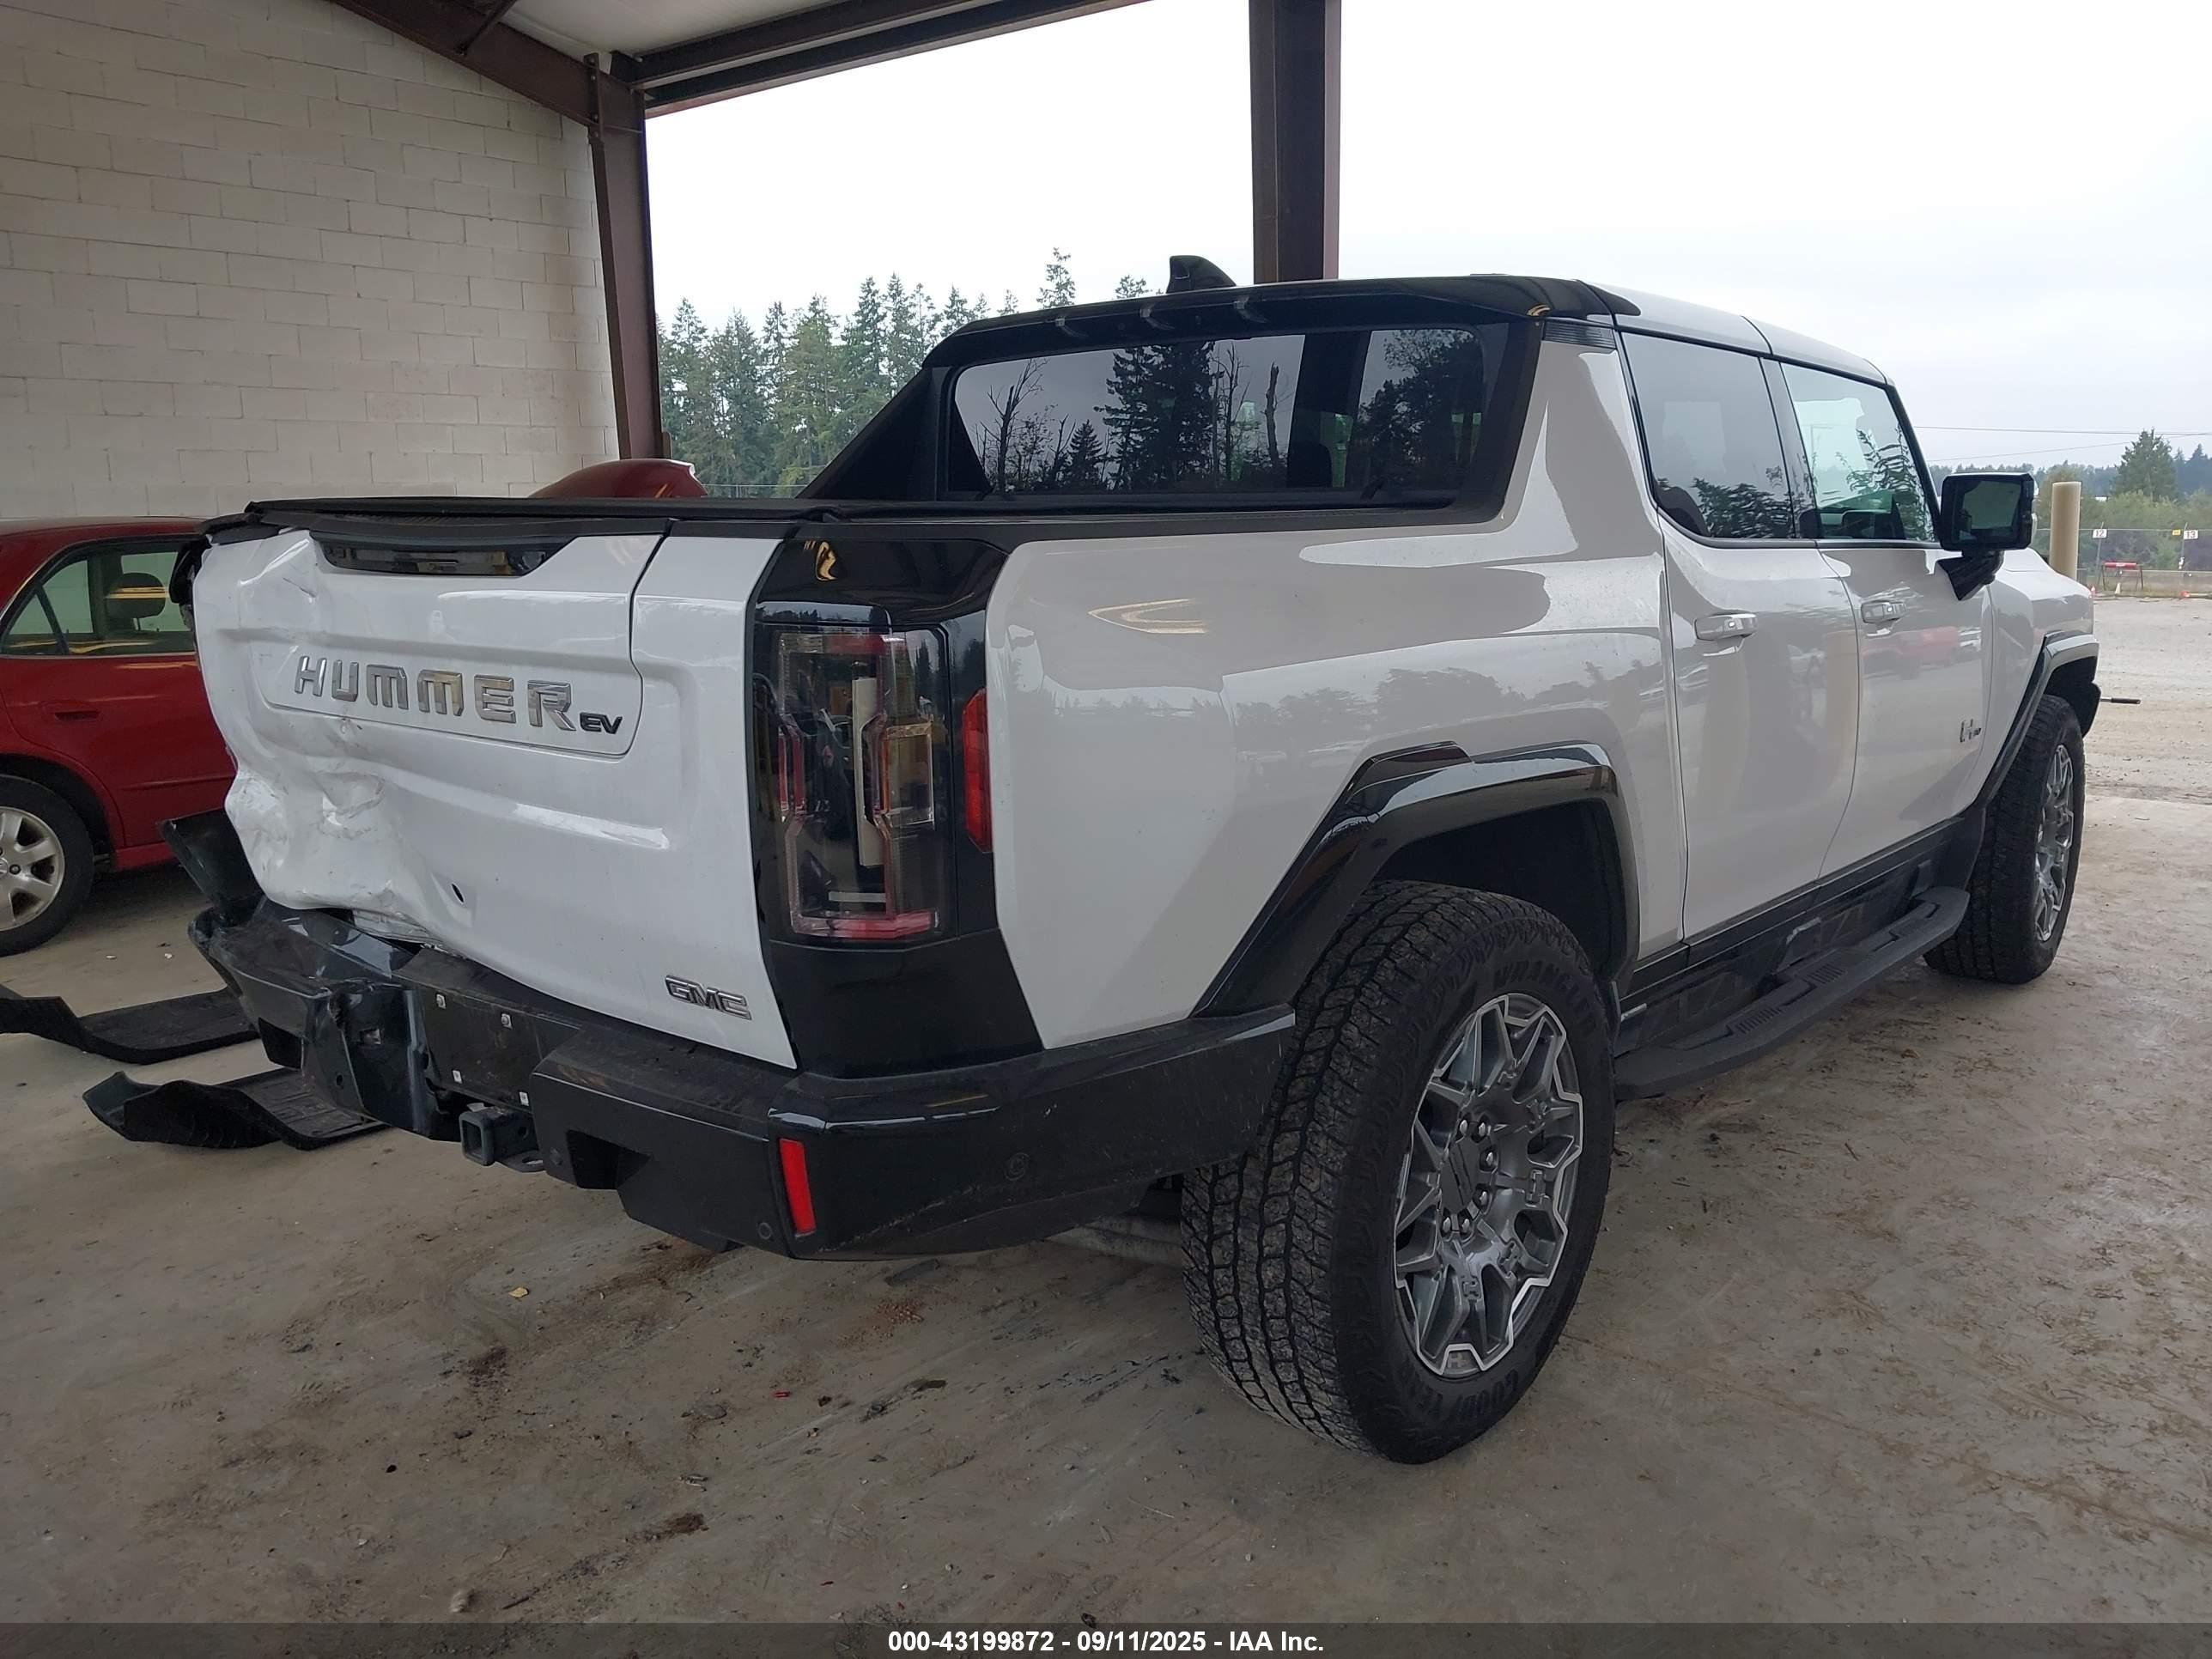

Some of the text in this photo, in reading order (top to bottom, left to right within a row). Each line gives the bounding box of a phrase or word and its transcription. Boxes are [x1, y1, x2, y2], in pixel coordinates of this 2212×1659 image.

[295, 655, 623, 734] HUMMER EV
[665, 975, 752, 1020] GMC
